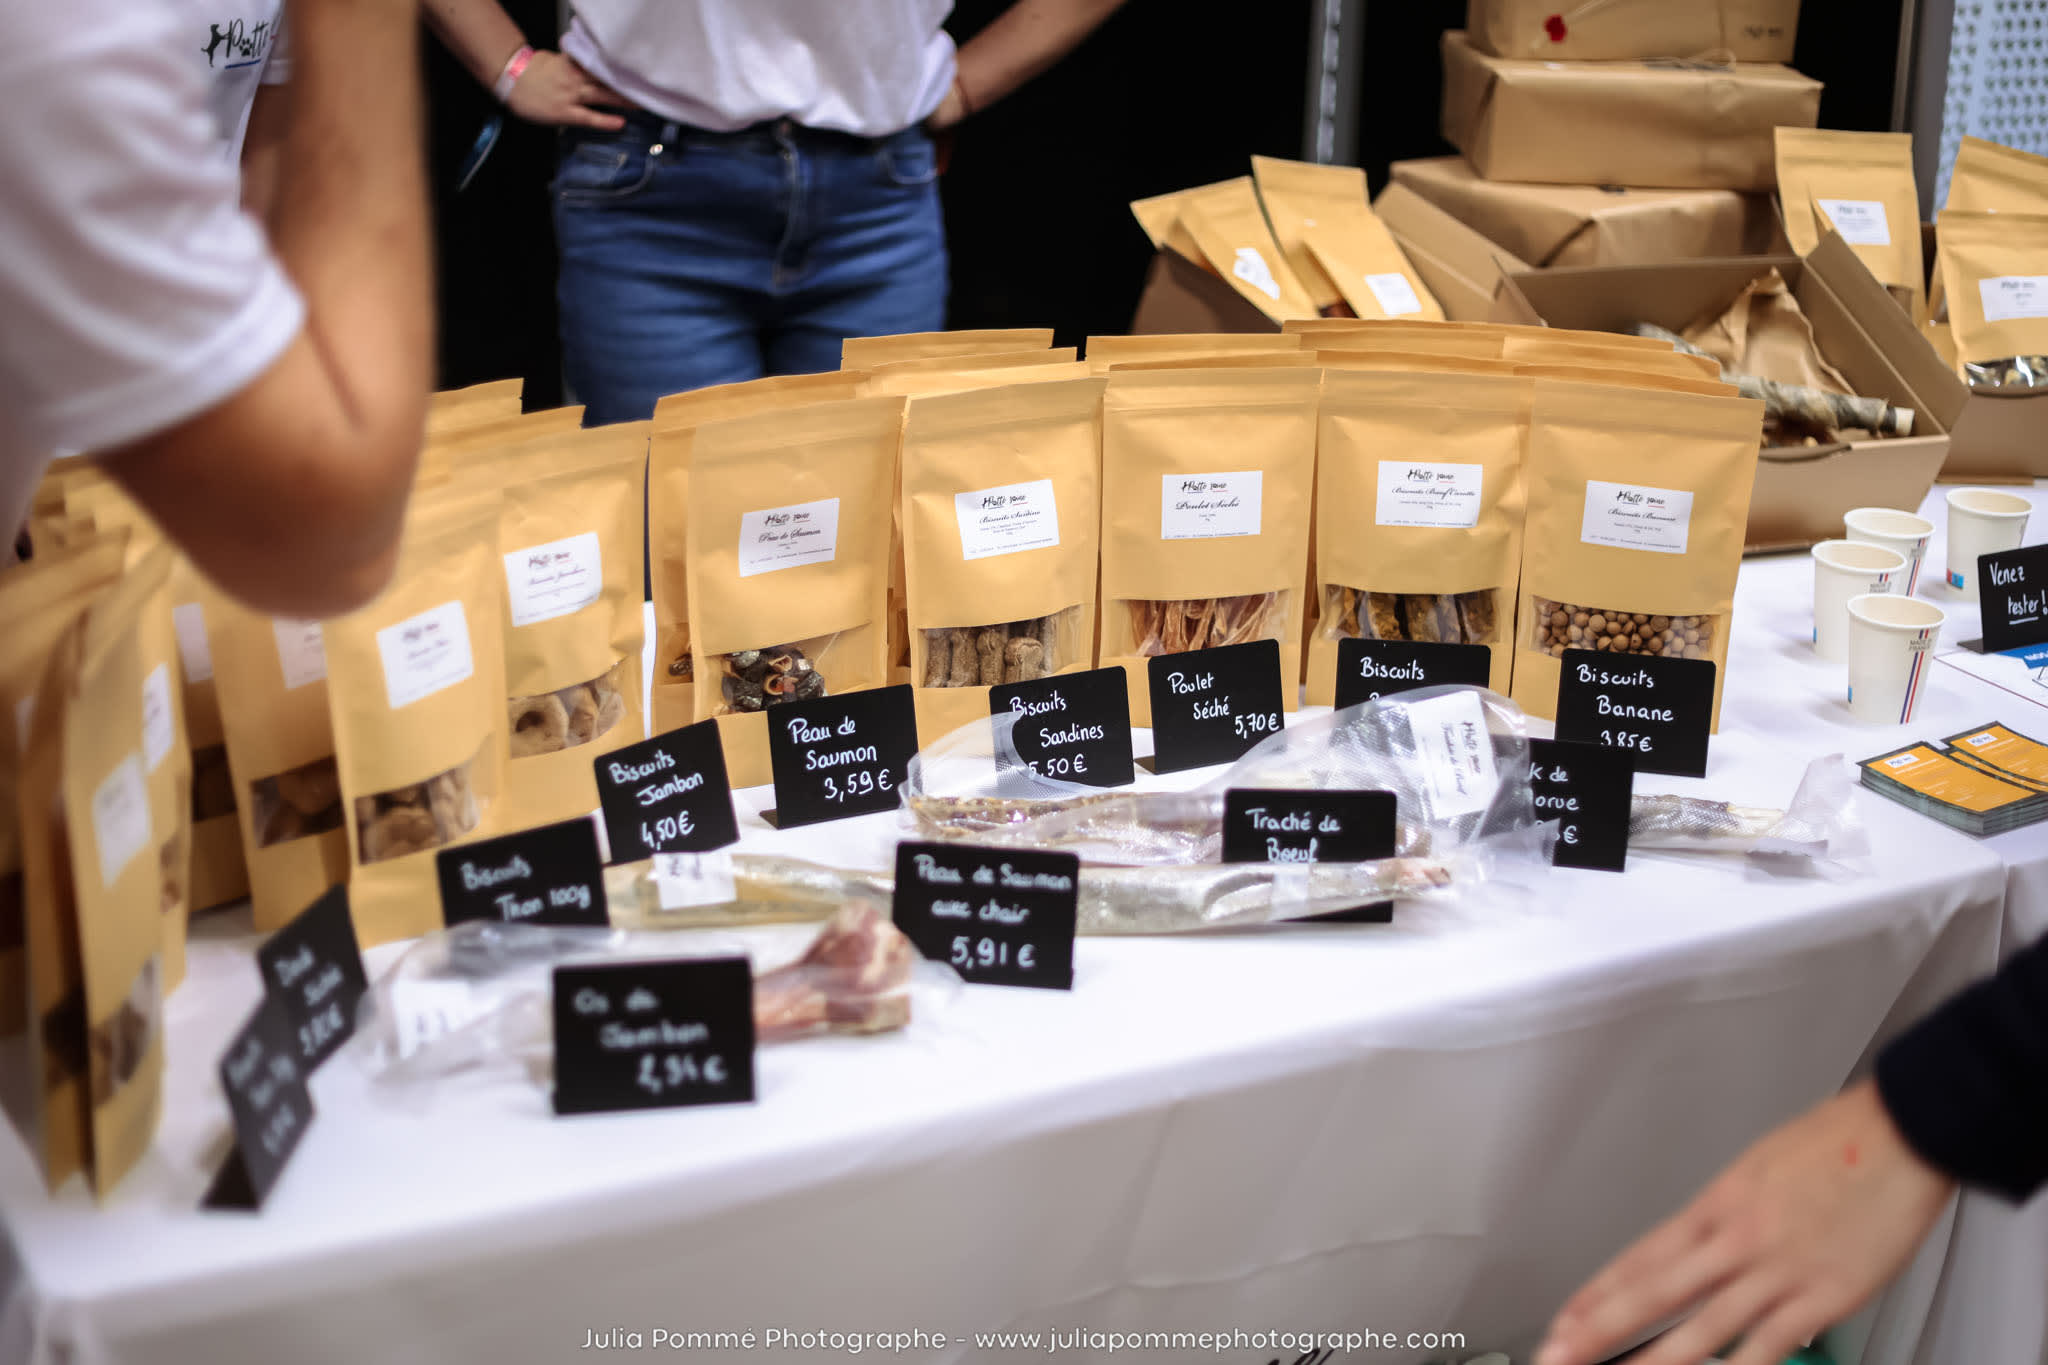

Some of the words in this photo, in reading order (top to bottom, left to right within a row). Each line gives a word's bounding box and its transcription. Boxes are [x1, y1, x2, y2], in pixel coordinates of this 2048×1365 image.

[1989, 561, 2025, 586] Venez
[1360, 656, 1424, 680] Biscuits
[1576, 663, 1654, 688] Biscuits
[1167, 671, 1215, 694] Poulet
[1009, 690, 1067, 716] Biscuits
[1193, 696, 1230, 720] Séché
[1596, 694, 1674, 722] Banane
[787, 717, 831, 744] Peau
[837, 715, 856, 735] de
[1039, 722, 1104, 747] Sardines
[608, 749, 676, 784] Biscuits
[805, 745, 878, 770] Saumon
[1549, 766, 1568, 782] de
[636, 772, 704, 806] Jambon
[1535, 795, 1580, 811] orue
[1318, 814, 1341, 833] de
